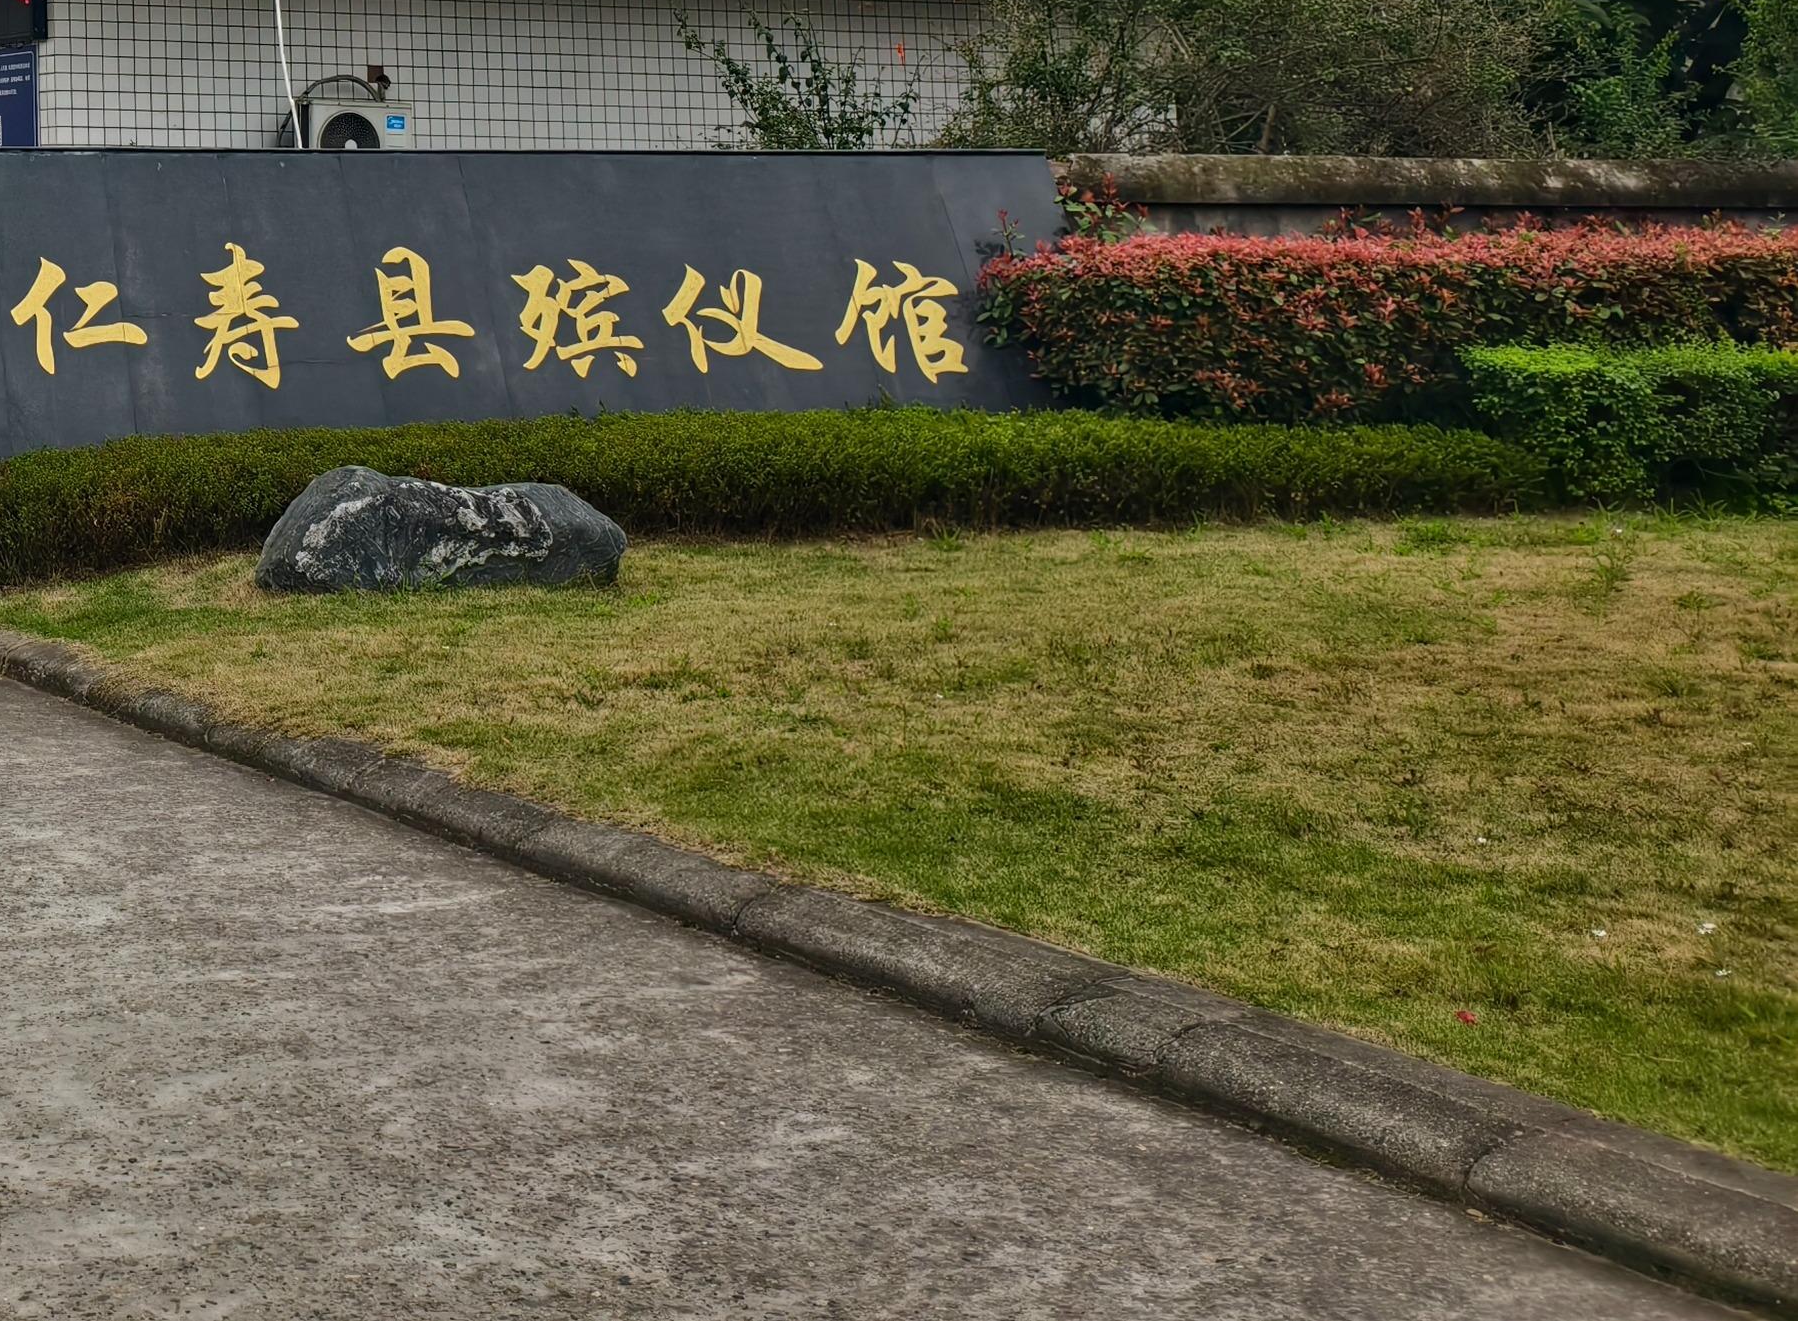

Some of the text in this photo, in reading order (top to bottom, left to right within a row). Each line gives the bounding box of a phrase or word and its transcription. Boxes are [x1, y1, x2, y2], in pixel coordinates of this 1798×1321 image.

[9, 242, 969, 389] 仁寿县殡仪馆
